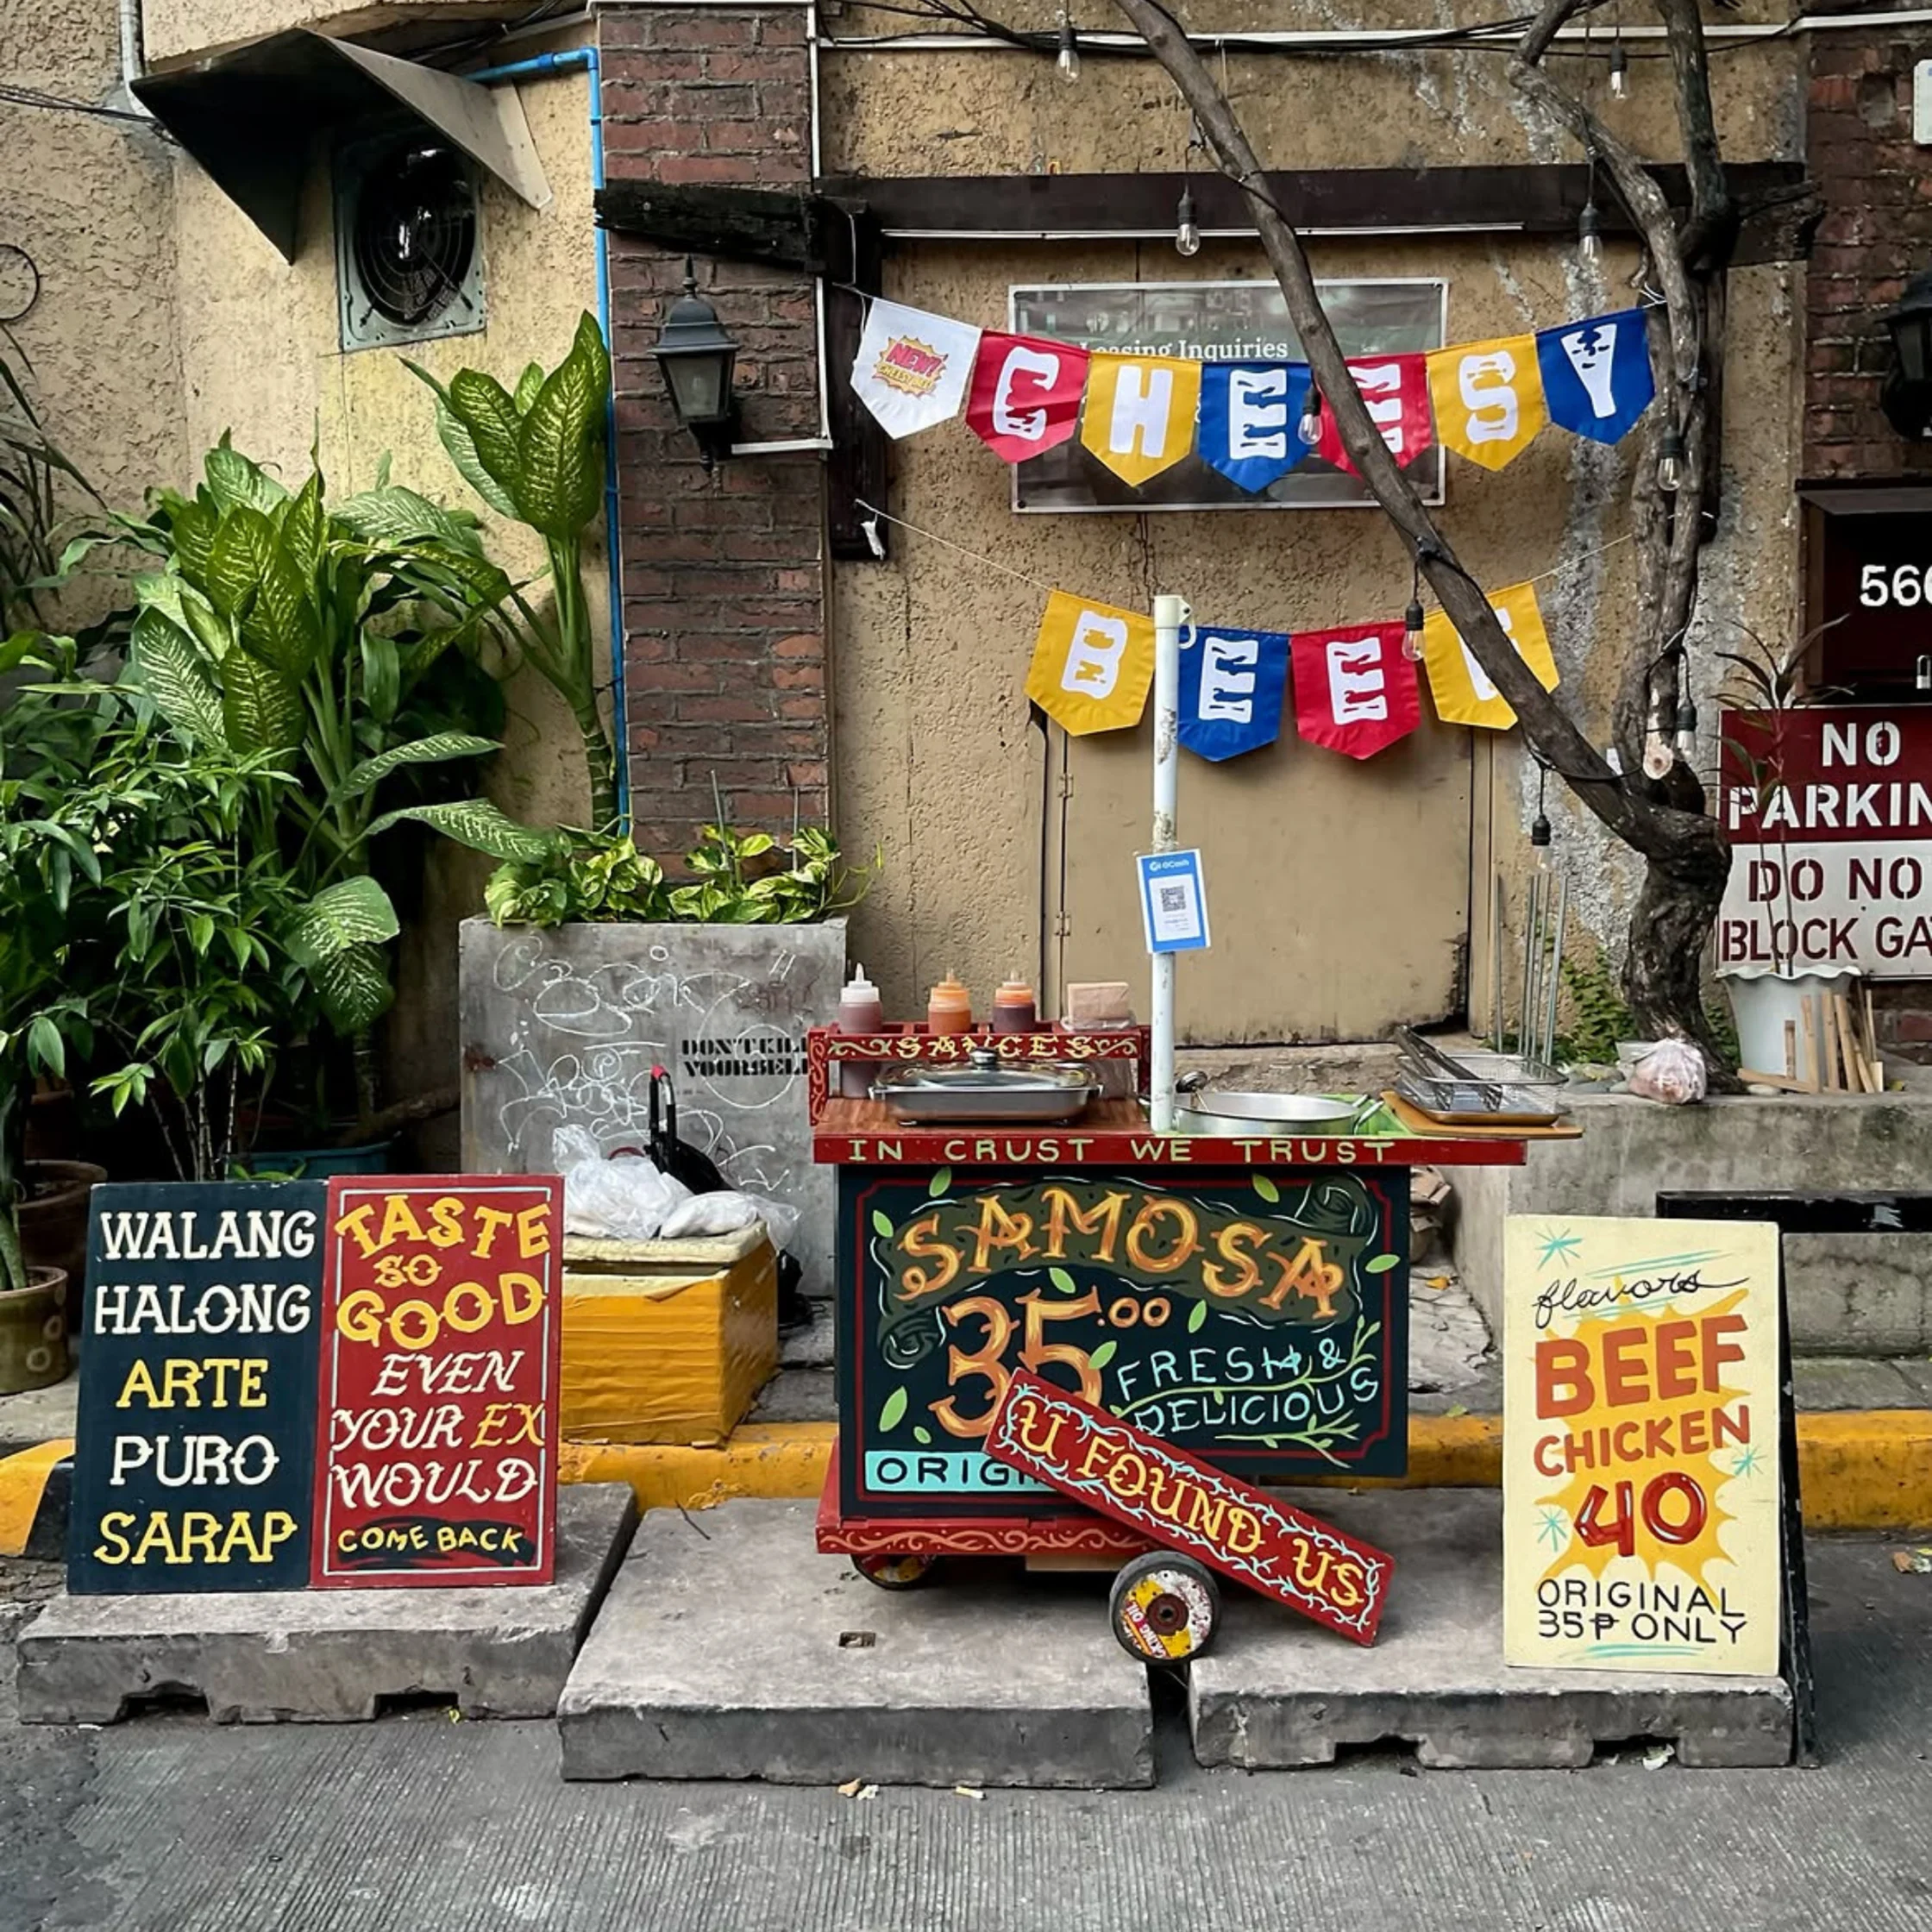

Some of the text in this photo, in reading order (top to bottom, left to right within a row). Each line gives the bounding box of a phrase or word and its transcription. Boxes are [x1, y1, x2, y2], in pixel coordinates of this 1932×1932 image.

[885, 342, 942, 378] NEW!
[1179, 337, 1289, 361] Inquiries
[1860, 564, 1932, 606] 56
[1822, 721, 1900, 767] NO
[1728, 782, 1932, 830] PARKIN
[1748, 859, 1824, 901] DO
[1722, 915, 1932, 962] BLOCK GA
[849, 1138, 1395, 1164] IN CRUST WE TRUST
[99, 1210, 317, 1260] WALANG
[334, 1195, 552, 1259] TASTE
[374, 1253, 442, 1288] SO
[894, 1186, 1346, 1320] SAMOSA
[94, 1284, 311, 1334] HALONG
[336, 1272, 548, 1350] GOOD
[1533, 1269, 1750, 1329] flavors
[115, 1358, 269, 1409] ARTE
[370, 1350, 524, 1397] EVEN
[1116, 1338, 1346, 1401] FRESH &
[1534, 1314, 1750, 1421] BEEF
[330, 1402, 546, 1452] YOUR EX
[1134, 1367, 1378, 1437] DELICIOUS
[110, 1434, 280, 1487] PURO
[1534, 1404, 1750, 1477] CHICKEN
[329, 1459, 539, 1509] WOULD
[1019, 1400, 1365, 1609] U FOUND US
[93, 1510, 298, 1565] SARAP
[337, 1524, 524, 1553] COME BACK
[1573, 1471, 1708, 1558] 40
[1126, 1601, 1145, 1622] OIL
[1537, 1578, 1746, 1618] ORIGINAL
[1631, 1613, 1747, 1644] ONLY
